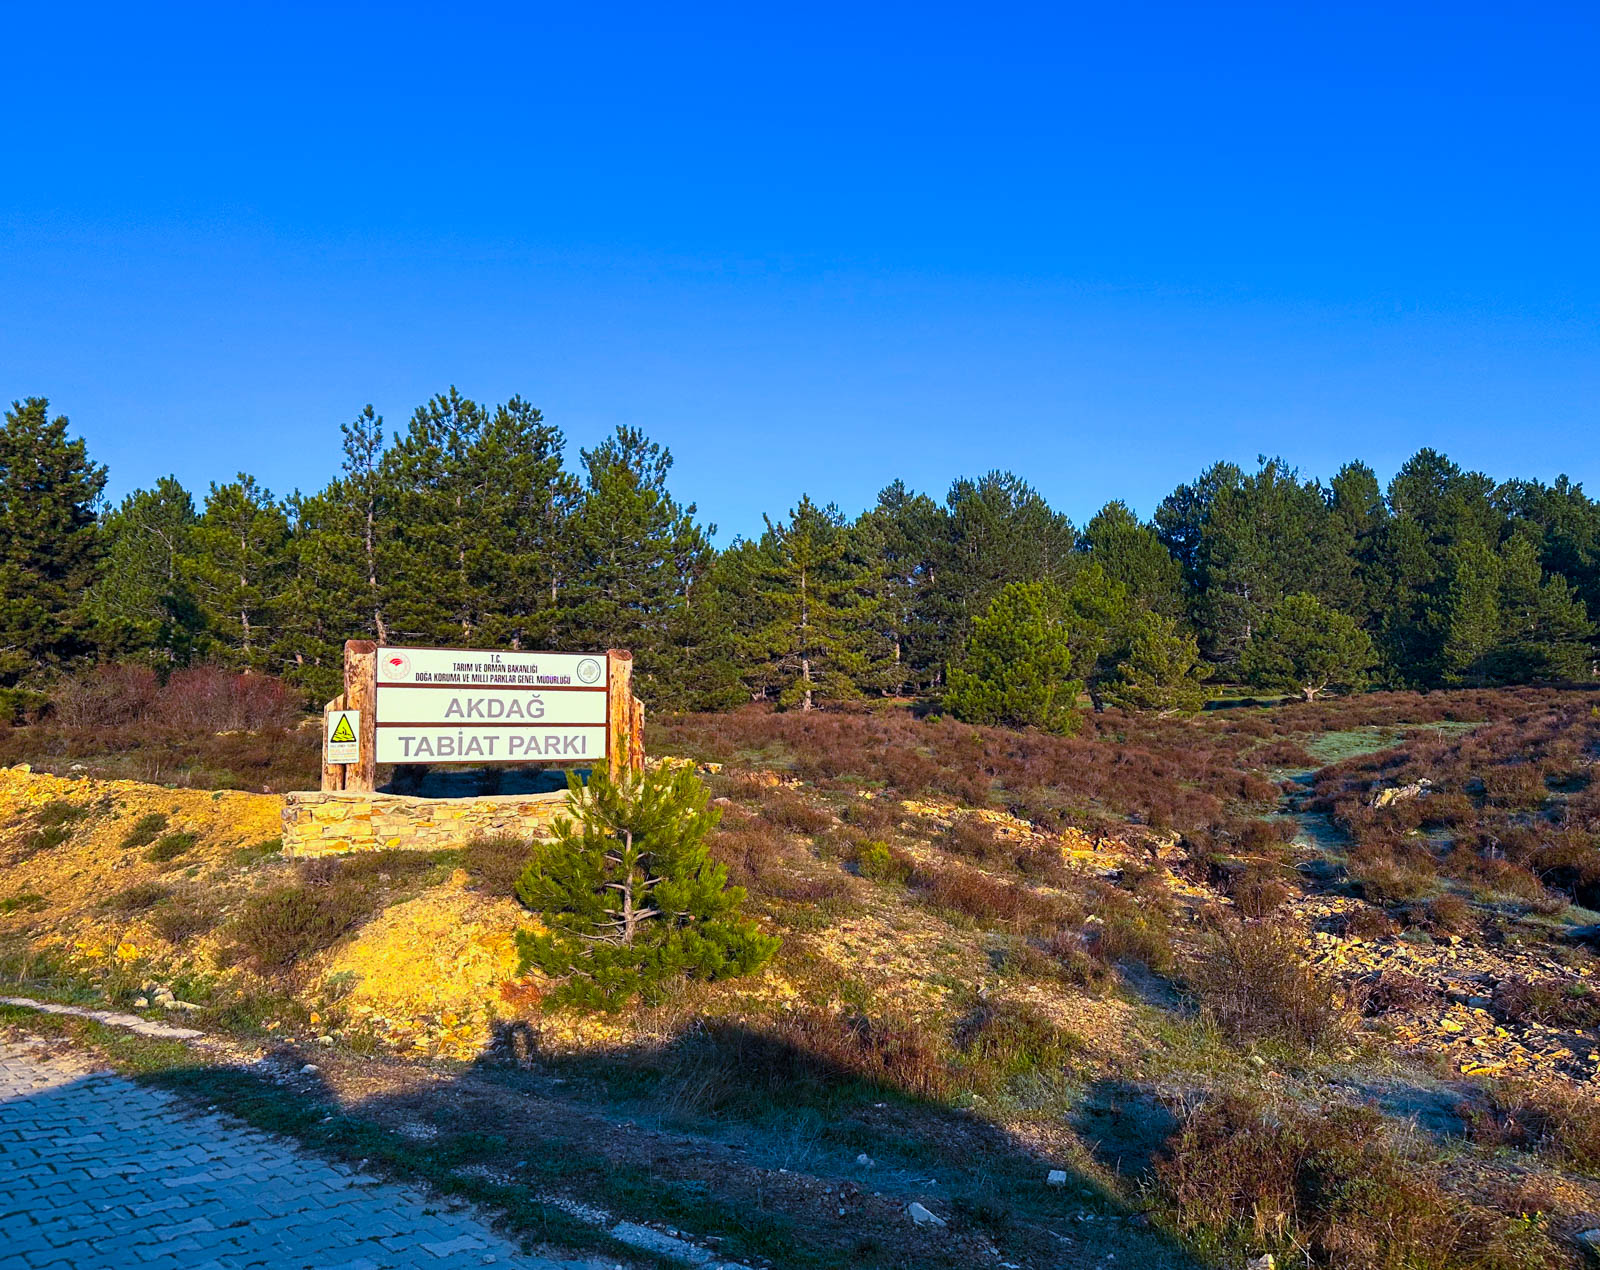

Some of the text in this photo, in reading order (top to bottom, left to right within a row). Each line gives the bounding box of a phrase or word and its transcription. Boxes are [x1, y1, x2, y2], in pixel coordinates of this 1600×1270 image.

[453, 663, 473, 672] TARIM
[475, 663, 482, 672] VE
[484, 664, 506, 673] ORMAN
[434, 673, 461, 682] KORUMA
[462, 673, 469, 682] VE
[490, 674, 516, 684] PARKLAR
[518, 675, 535, 684] GENEL
[444, 694, 545, 719] AKDAĞ
[398, 731, 587, 757] TABİAT PARKI
